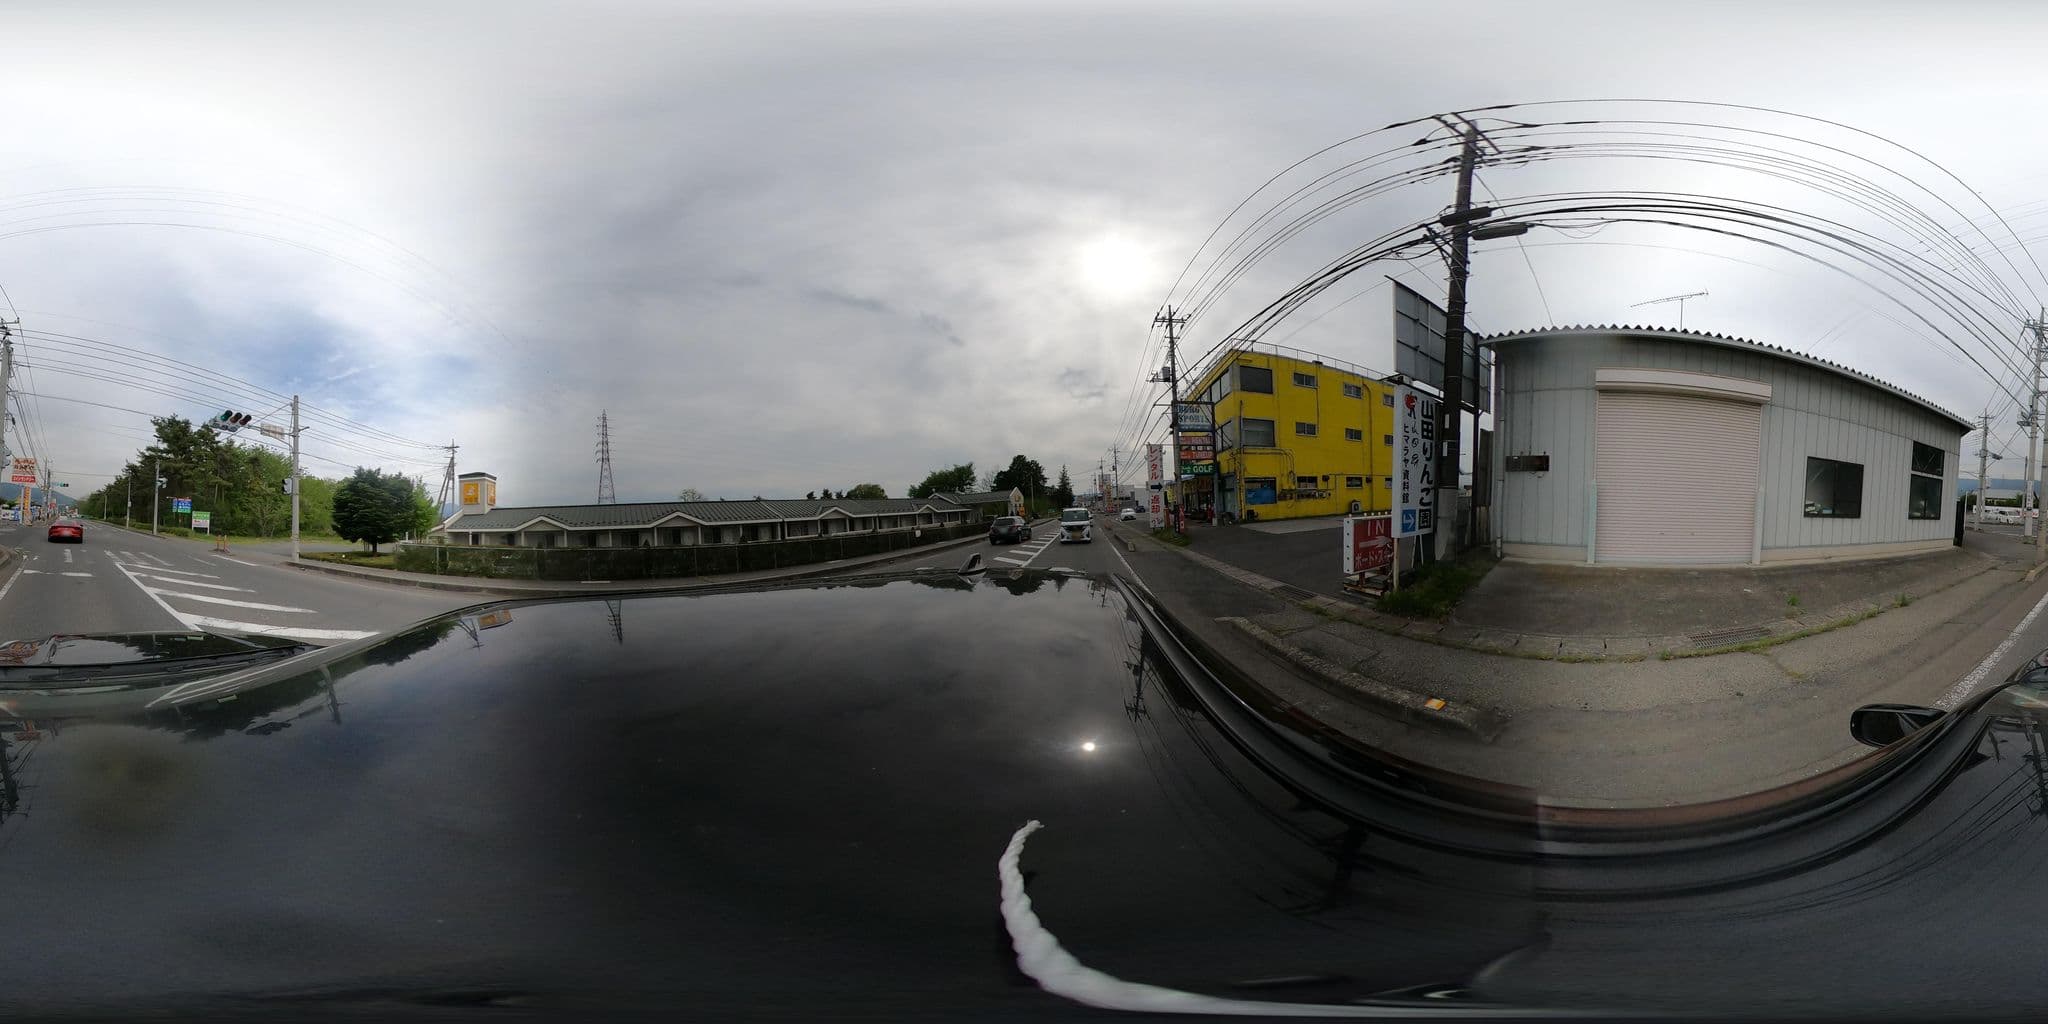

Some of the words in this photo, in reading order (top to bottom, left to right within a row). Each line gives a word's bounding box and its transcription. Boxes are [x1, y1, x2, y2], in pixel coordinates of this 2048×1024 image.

[1149, 446, 1158, 480] レンタル
[1192, 465, 1213, 473] GOLF
[1367, 519, 1385, 537] IN
